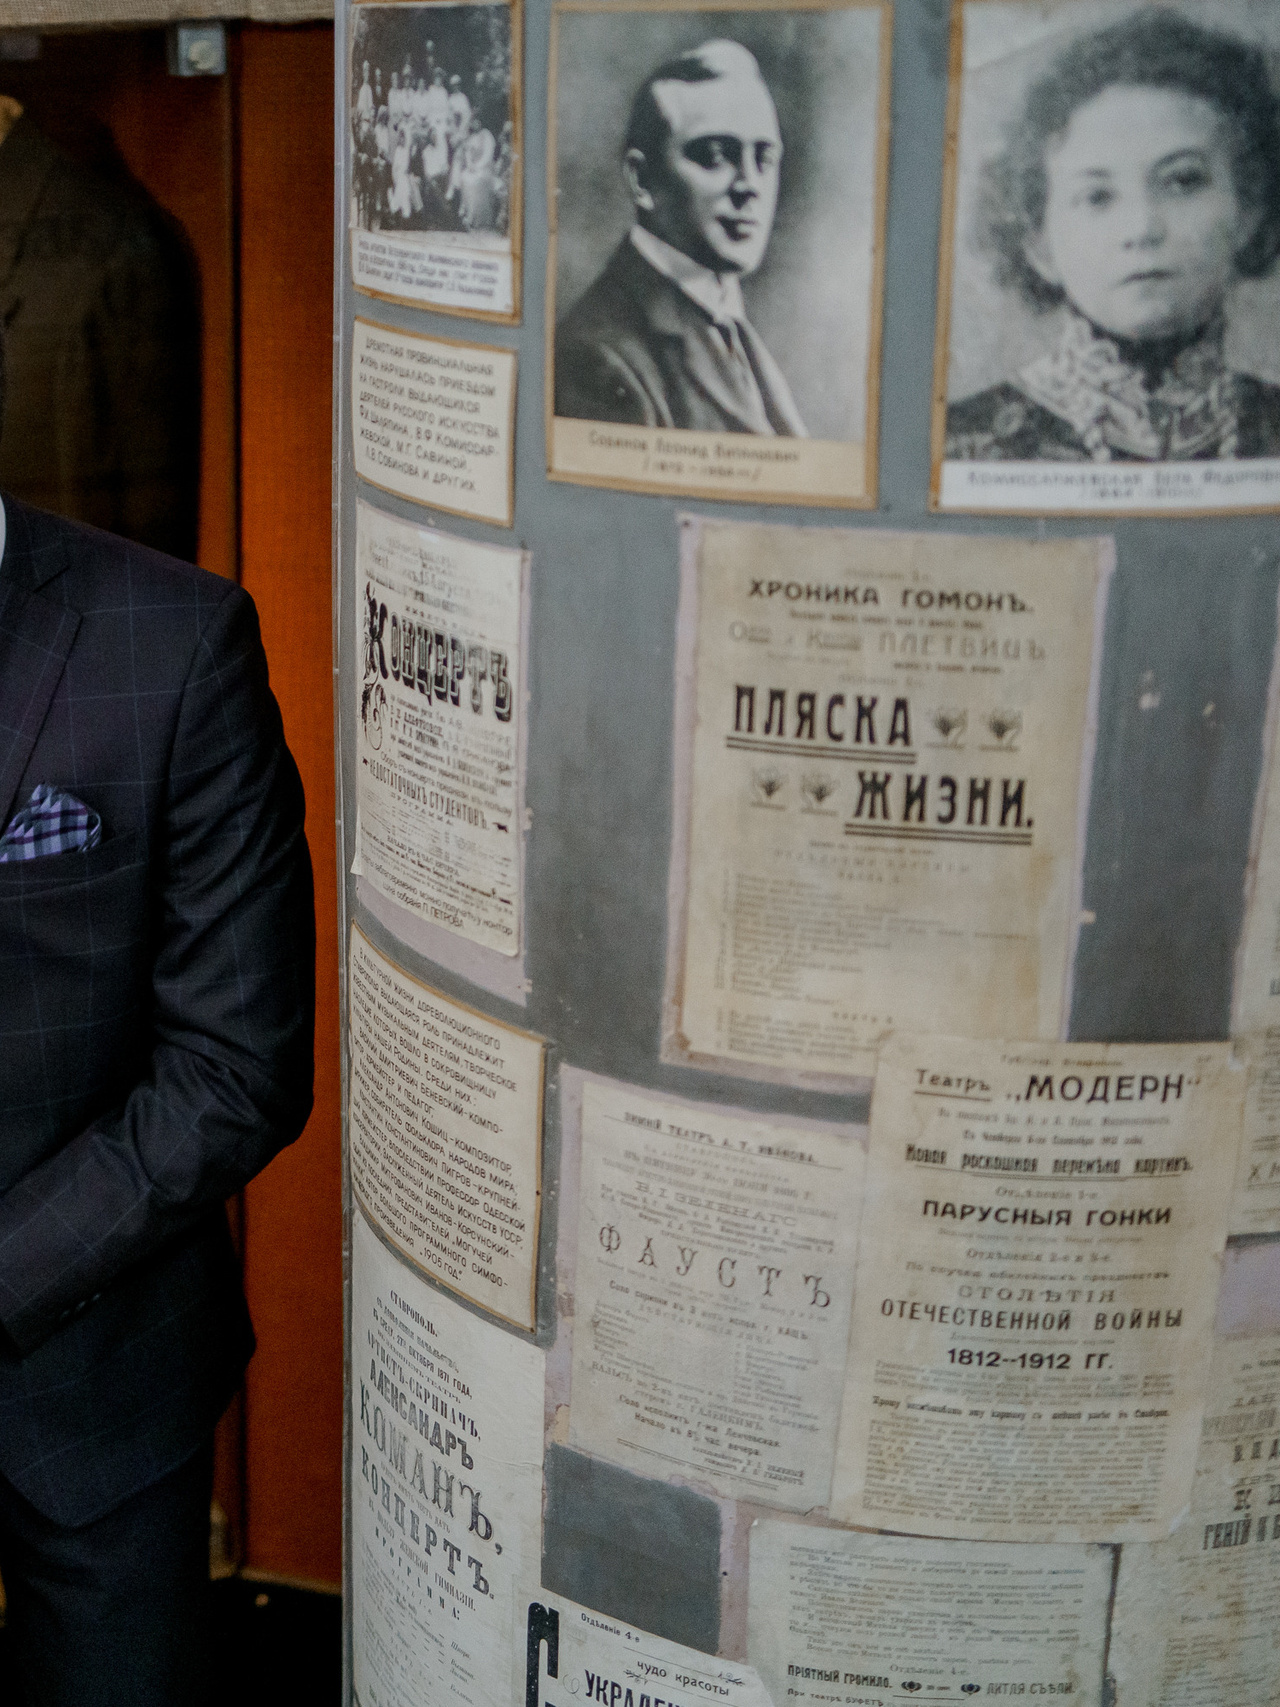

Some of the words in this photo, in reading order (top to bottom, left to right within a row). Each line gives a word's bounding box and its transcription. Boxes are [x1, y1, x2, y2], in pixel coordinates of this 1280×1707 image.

[408, 387, 481, 414] ВЫДАЮЩИХСЯ
[439, 374, 496, 397] ПРИЕЗДОМ
[393, 402, 436, 426] РУССКОГО
[438, 414, 500, 439] ИСКУССТВА
[748, 579, 879, 606] ХРОНИКА
[901, 588, 1035, 613] ГОМОНЪ.
[732, 683, 914, 749] ПЛЯСКА
[852, 770, 1035, 829] ЖИЗНИ.
[380, 986, 420, 1026] ВЫДАЮЩАЯСЯ
[422, 1017, 440, 1037] РОЛЬ
[441, 1030, 505, 1069] ПРИНАДЛЕЖИТ
[393, 981, 415, 1005] ЖИЗНИ
[417, 999, 501, 1050] ДОРЕВОЛЮЦИОННОГО
[373, 1013, 398, 1041] КОТОРЫХ
[399, 1035, 421, 1059] ВОШЛО
[430, 1057, 497, 1100] СОКРОВИЩНИЦУ
[373, 1029, 392, 1054] НАШЕЙ
[424, 1069, 453, 1092] СРЕДИ
[377, 1000, 420, 1041] МУЗЫКАЛЬНЫМ
[463, 1059, 518, 1092] ТВОРЧЕСКОЕ
[378, 1048, 419, 1091] ДМИТРИЕВИЧ
[384, 1087, 420, 1124] АНТОНОВИЧ
[914, 1067, 992, 1094] Театръ
[384, 1119, 439, 1169] КОНСТАНТИНОВИЧ
[404, 1120, 447, 1158] ФОЛЬКЛОРА
[448, 1150, 488, 1180] НАРОДОВ
[394, 1191, 451, 1242] ПРЕДСТАВИТЕЛЕЙ
[424, 1184, 456, 1212] ДЕЯТЕЛЬ
[457, 1203, 498, 1236] ИСКУССТВ
[436, 1175, 481, 1208] ПРОФЕССОР
[482, 1200, 526, 1233] ОДЕССКОЙ
[921, 1199, 1073, 1228] ПАРУСНЫЯ
[1083, 1206, 1173, 1229] ГОНКИ
[379, 1192, 407, 1227] БОЛЬШОГО
[408, 1219, 468, 1269] ПРОГРАММНОГО
[470, 1260, 509, 1288] СИМФО-
[880, 1297, 1072, 1332] ОТЕЧЕСТВЕННОЙ
[1093, 1307, 1184, 1331] ВОЙНЫ
[369, 1356, 475, 1472] АЛЕКСАНДРЪ
[360, 1443, 496, 1600] КОНЦЕРТЪ.
[580, 1611, 621, 1638] Отдѣленіе
[636, 1660, 668, 1680] чудо
[674, 1673, 731, 1698] красоты
[786, 1663, 842, 1686] ПРІЯТНЫЙ
